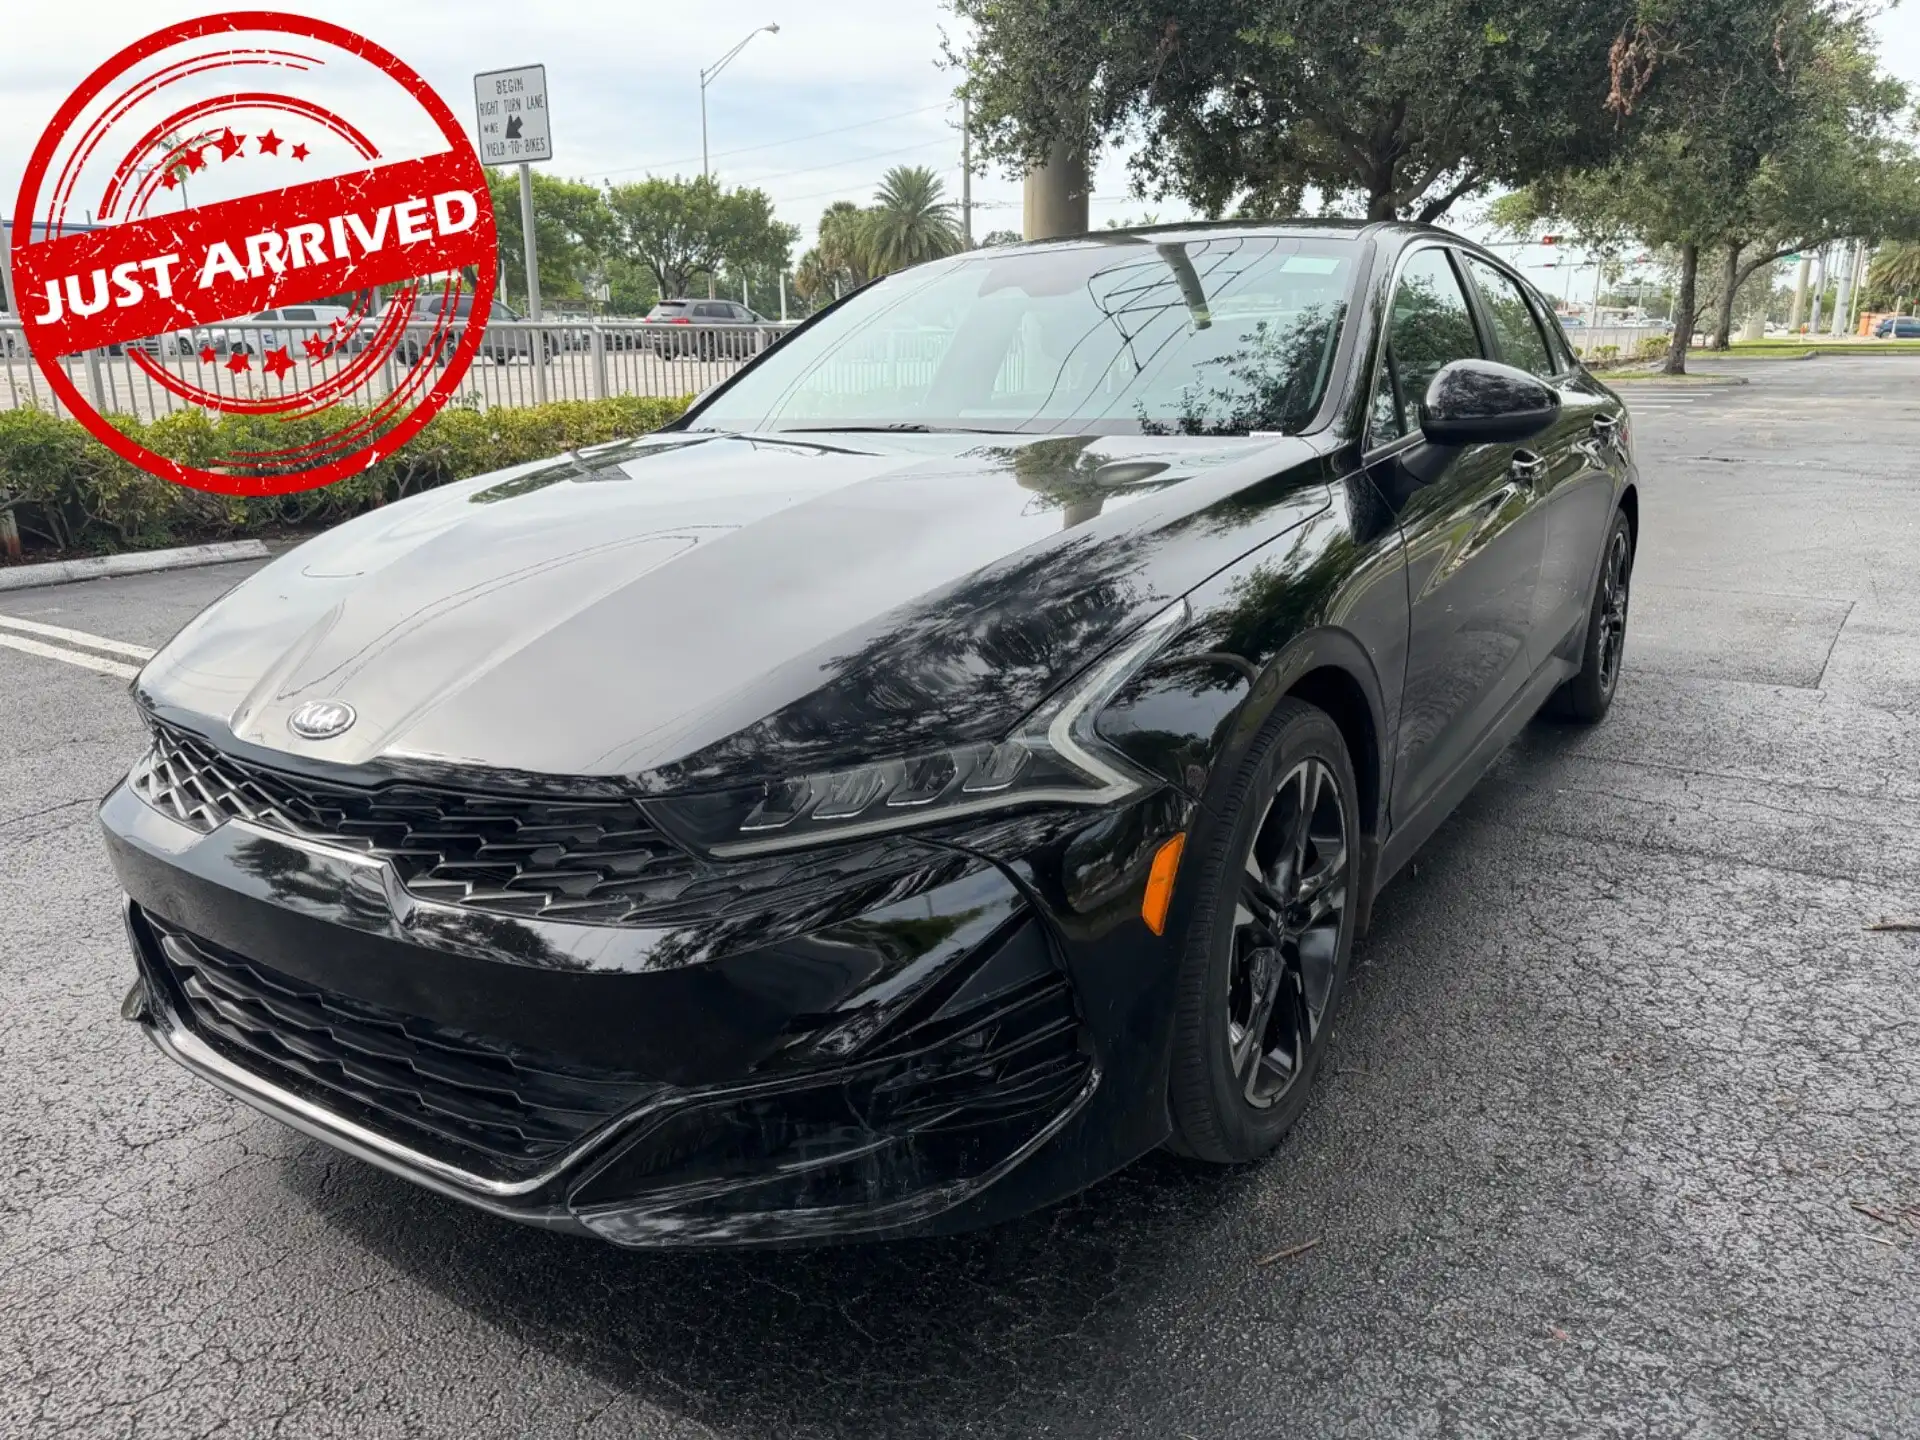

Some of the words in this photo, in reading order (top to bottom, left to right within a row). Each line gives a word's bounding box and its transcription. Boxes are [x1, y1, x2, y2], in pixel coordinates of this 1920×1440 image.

[496, 78, 524, 95] BEGIN
[480, 100, 499, 116] RIGHT
[504, 97, 521, 113] TURN
[526, 94, 544, 110] LANE
[486, 141, 505, 157] YIELD
[524, 137, 546, 153] BIKES
[294, 703, 342, 732] KIA
